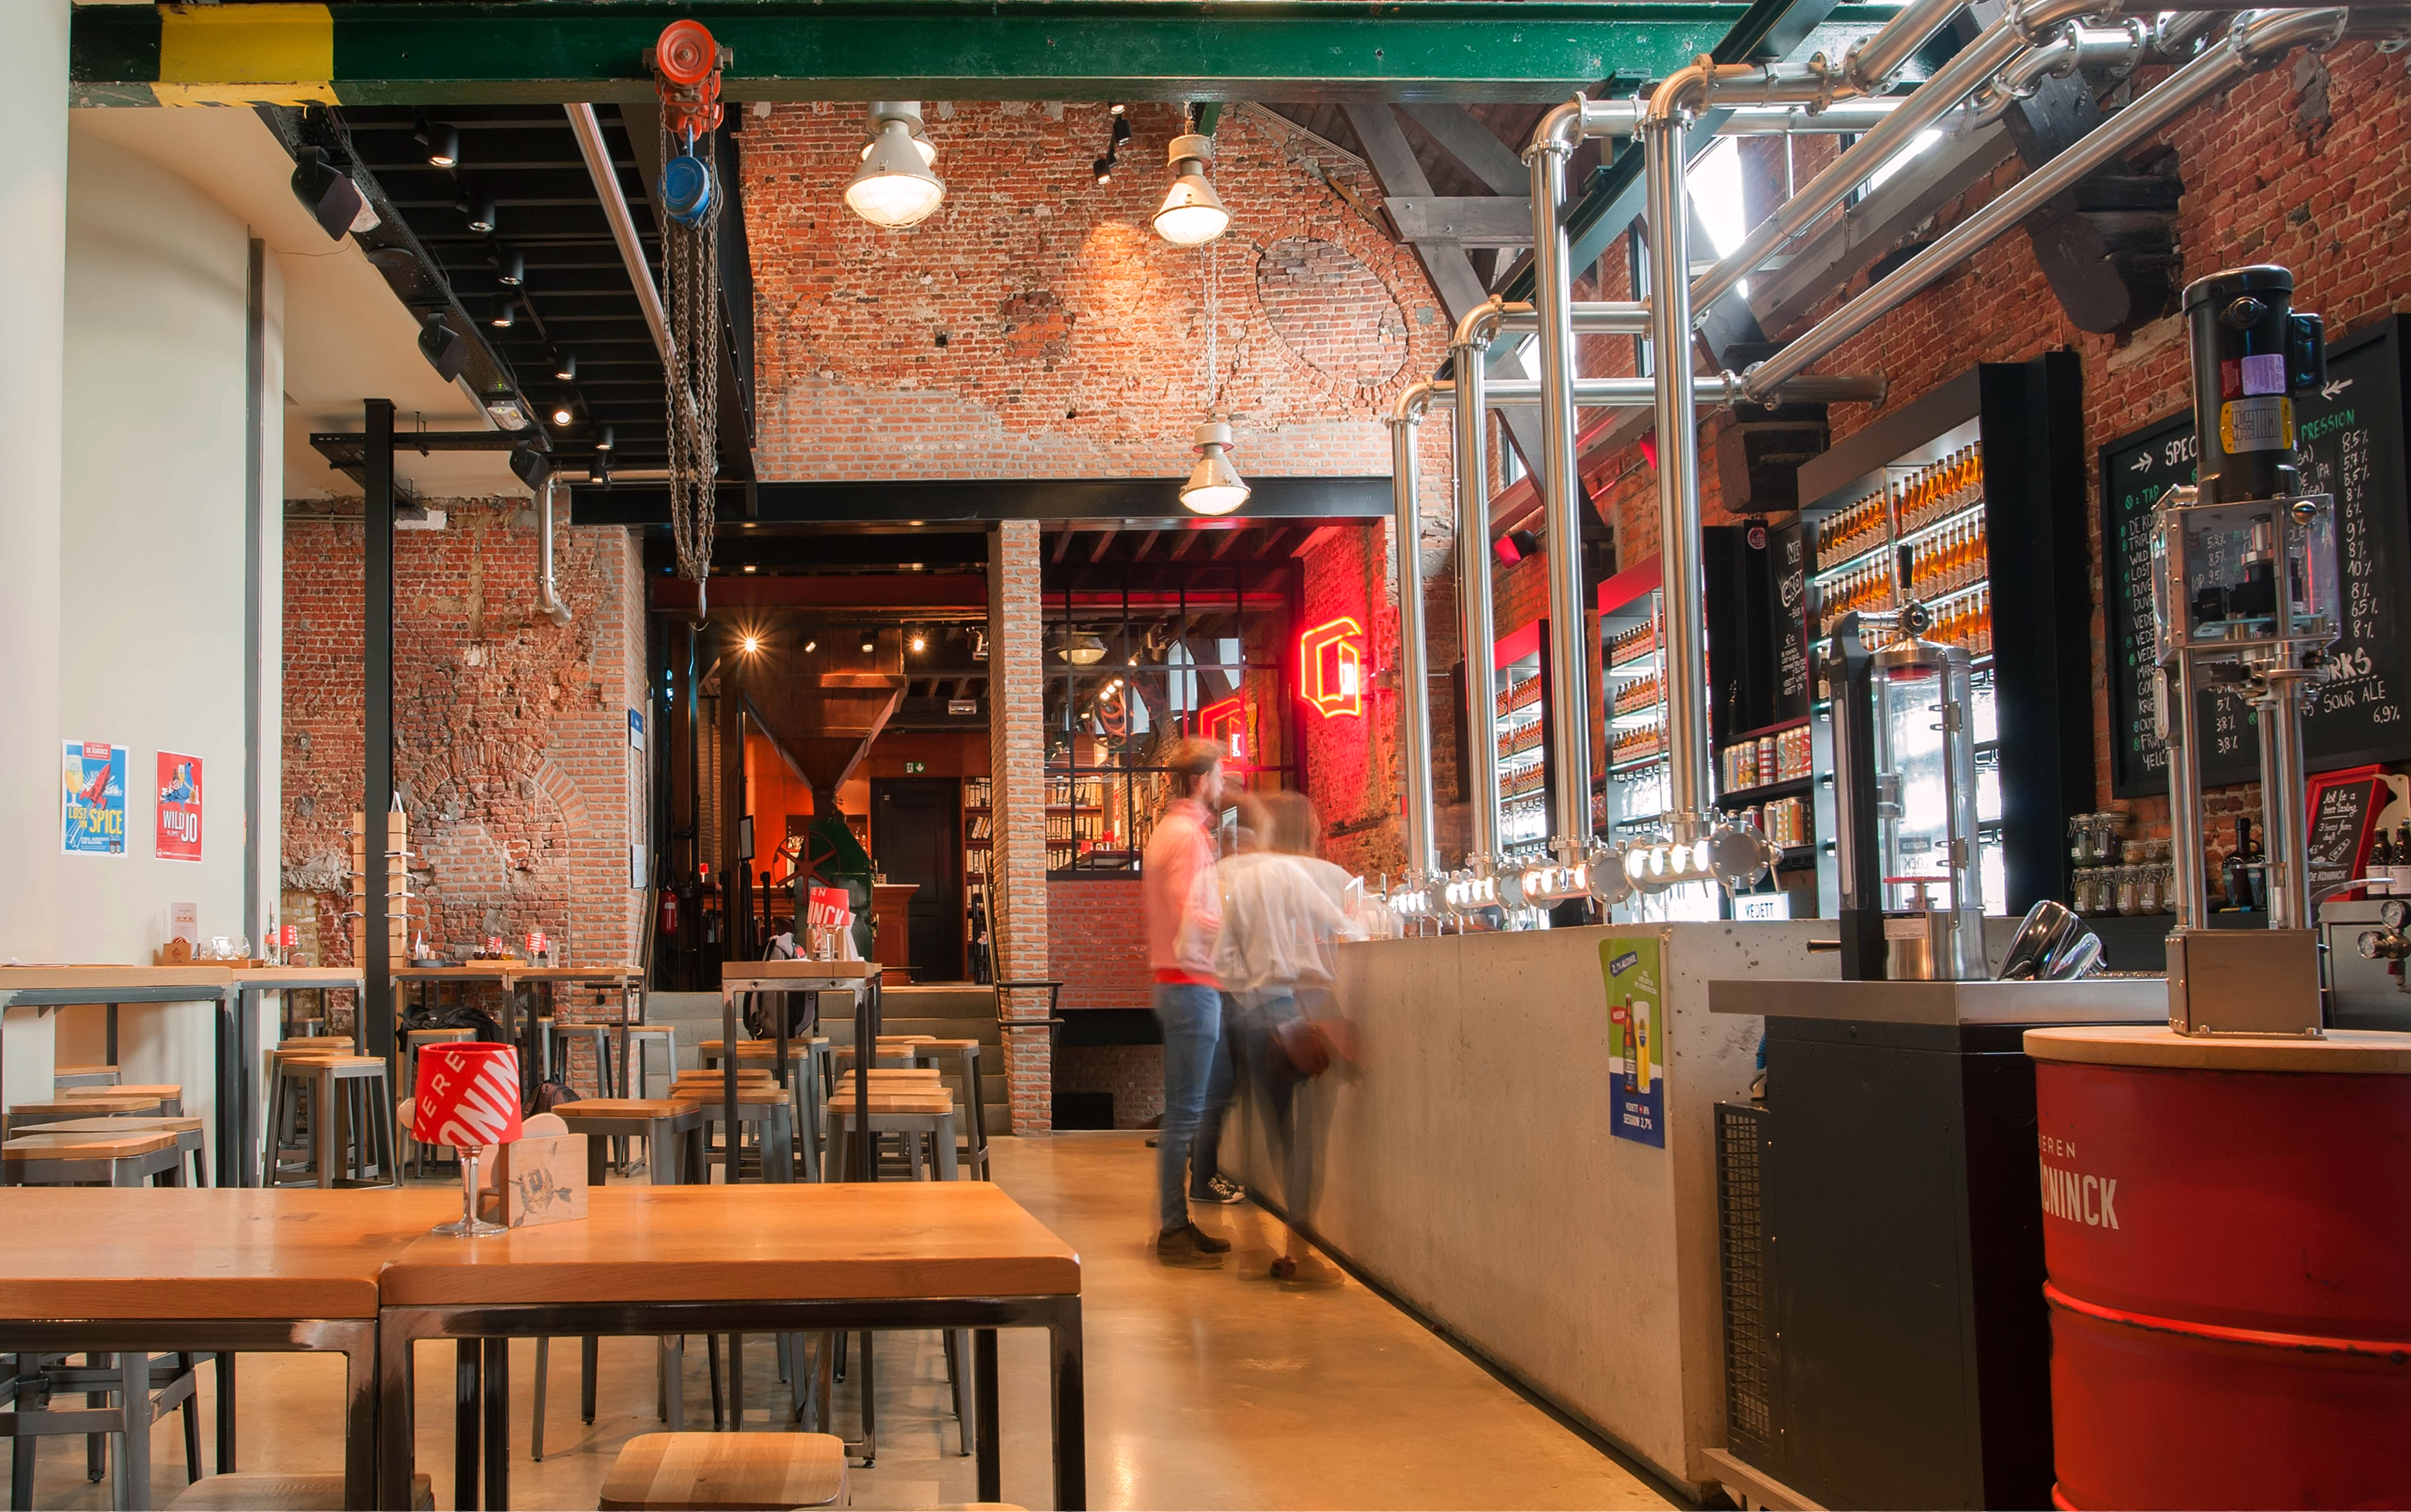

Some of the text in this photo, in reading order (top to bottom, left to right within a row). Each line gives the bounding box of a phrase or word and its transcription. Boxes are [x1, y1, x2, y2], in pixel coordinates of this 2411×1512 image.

[2301, 409, 2354, 441] PRESSION
[2143, 485, 2159, 504] TAP
[2346, 485, 2362, 502] 8%
[2346, 502, 2362, 517] 6%
[2129, 517, 2140, 536] DE
[2129, 550, 2148, 565] WILD
[2349, 540, 2366, 559] 8%
[2131, 562, 2151, 580] LOST
[2347, 560, 2372, 576] 10%
[2351, 582, 2370, 598] 8%
[2353, 620, 2374, 638] 8%
[2217, 696, 2230, 712] 5%
[2324, 691, 2355, 712] SOUR
[2363, 680, 2386, 703] ALE
[68, 807, 87, 819] LOST
[89, 809, 122, 835] SPICE
[163, 811, 184, 830] WILD
[181, 814, 197, 843] JO
[1745, 903, 1774, 918] VEDETT
